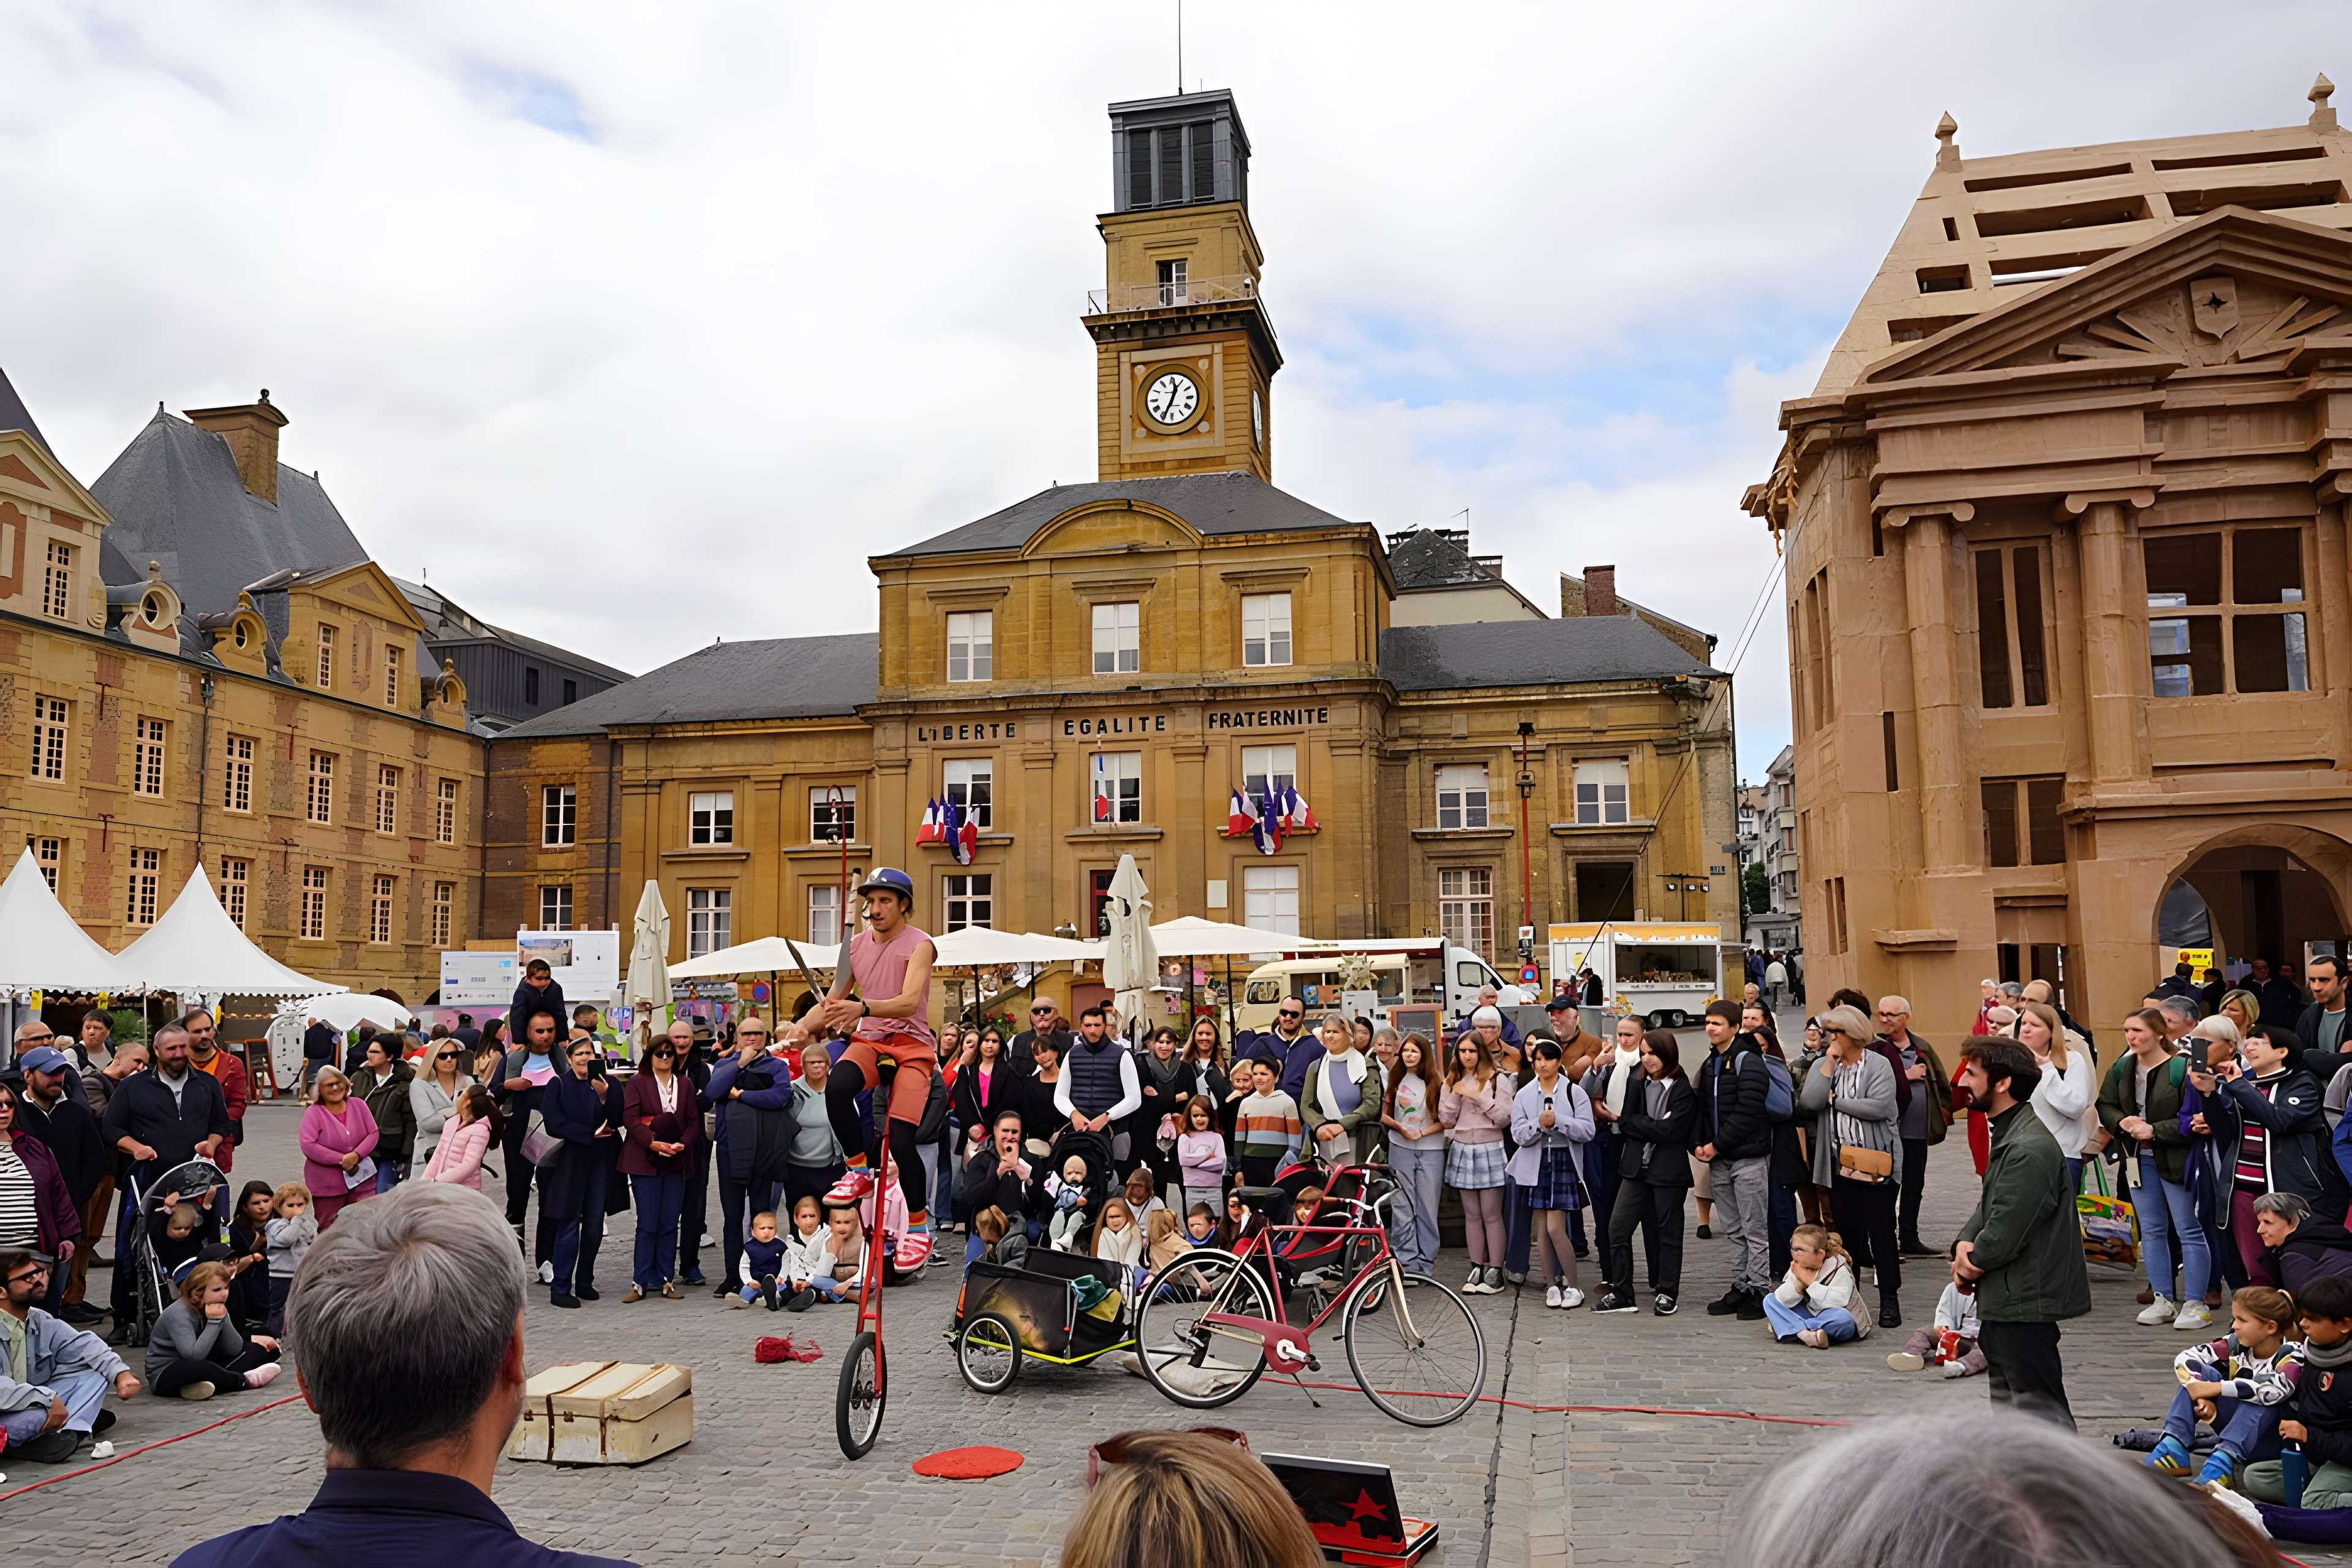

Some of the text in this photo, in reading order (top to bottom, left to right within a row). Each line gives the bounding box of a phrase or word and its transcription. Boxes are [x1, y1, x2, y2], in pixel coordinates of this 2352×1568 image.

[918, 707, 1329, 742] LIBERTE EGALITE FRATERNITE
